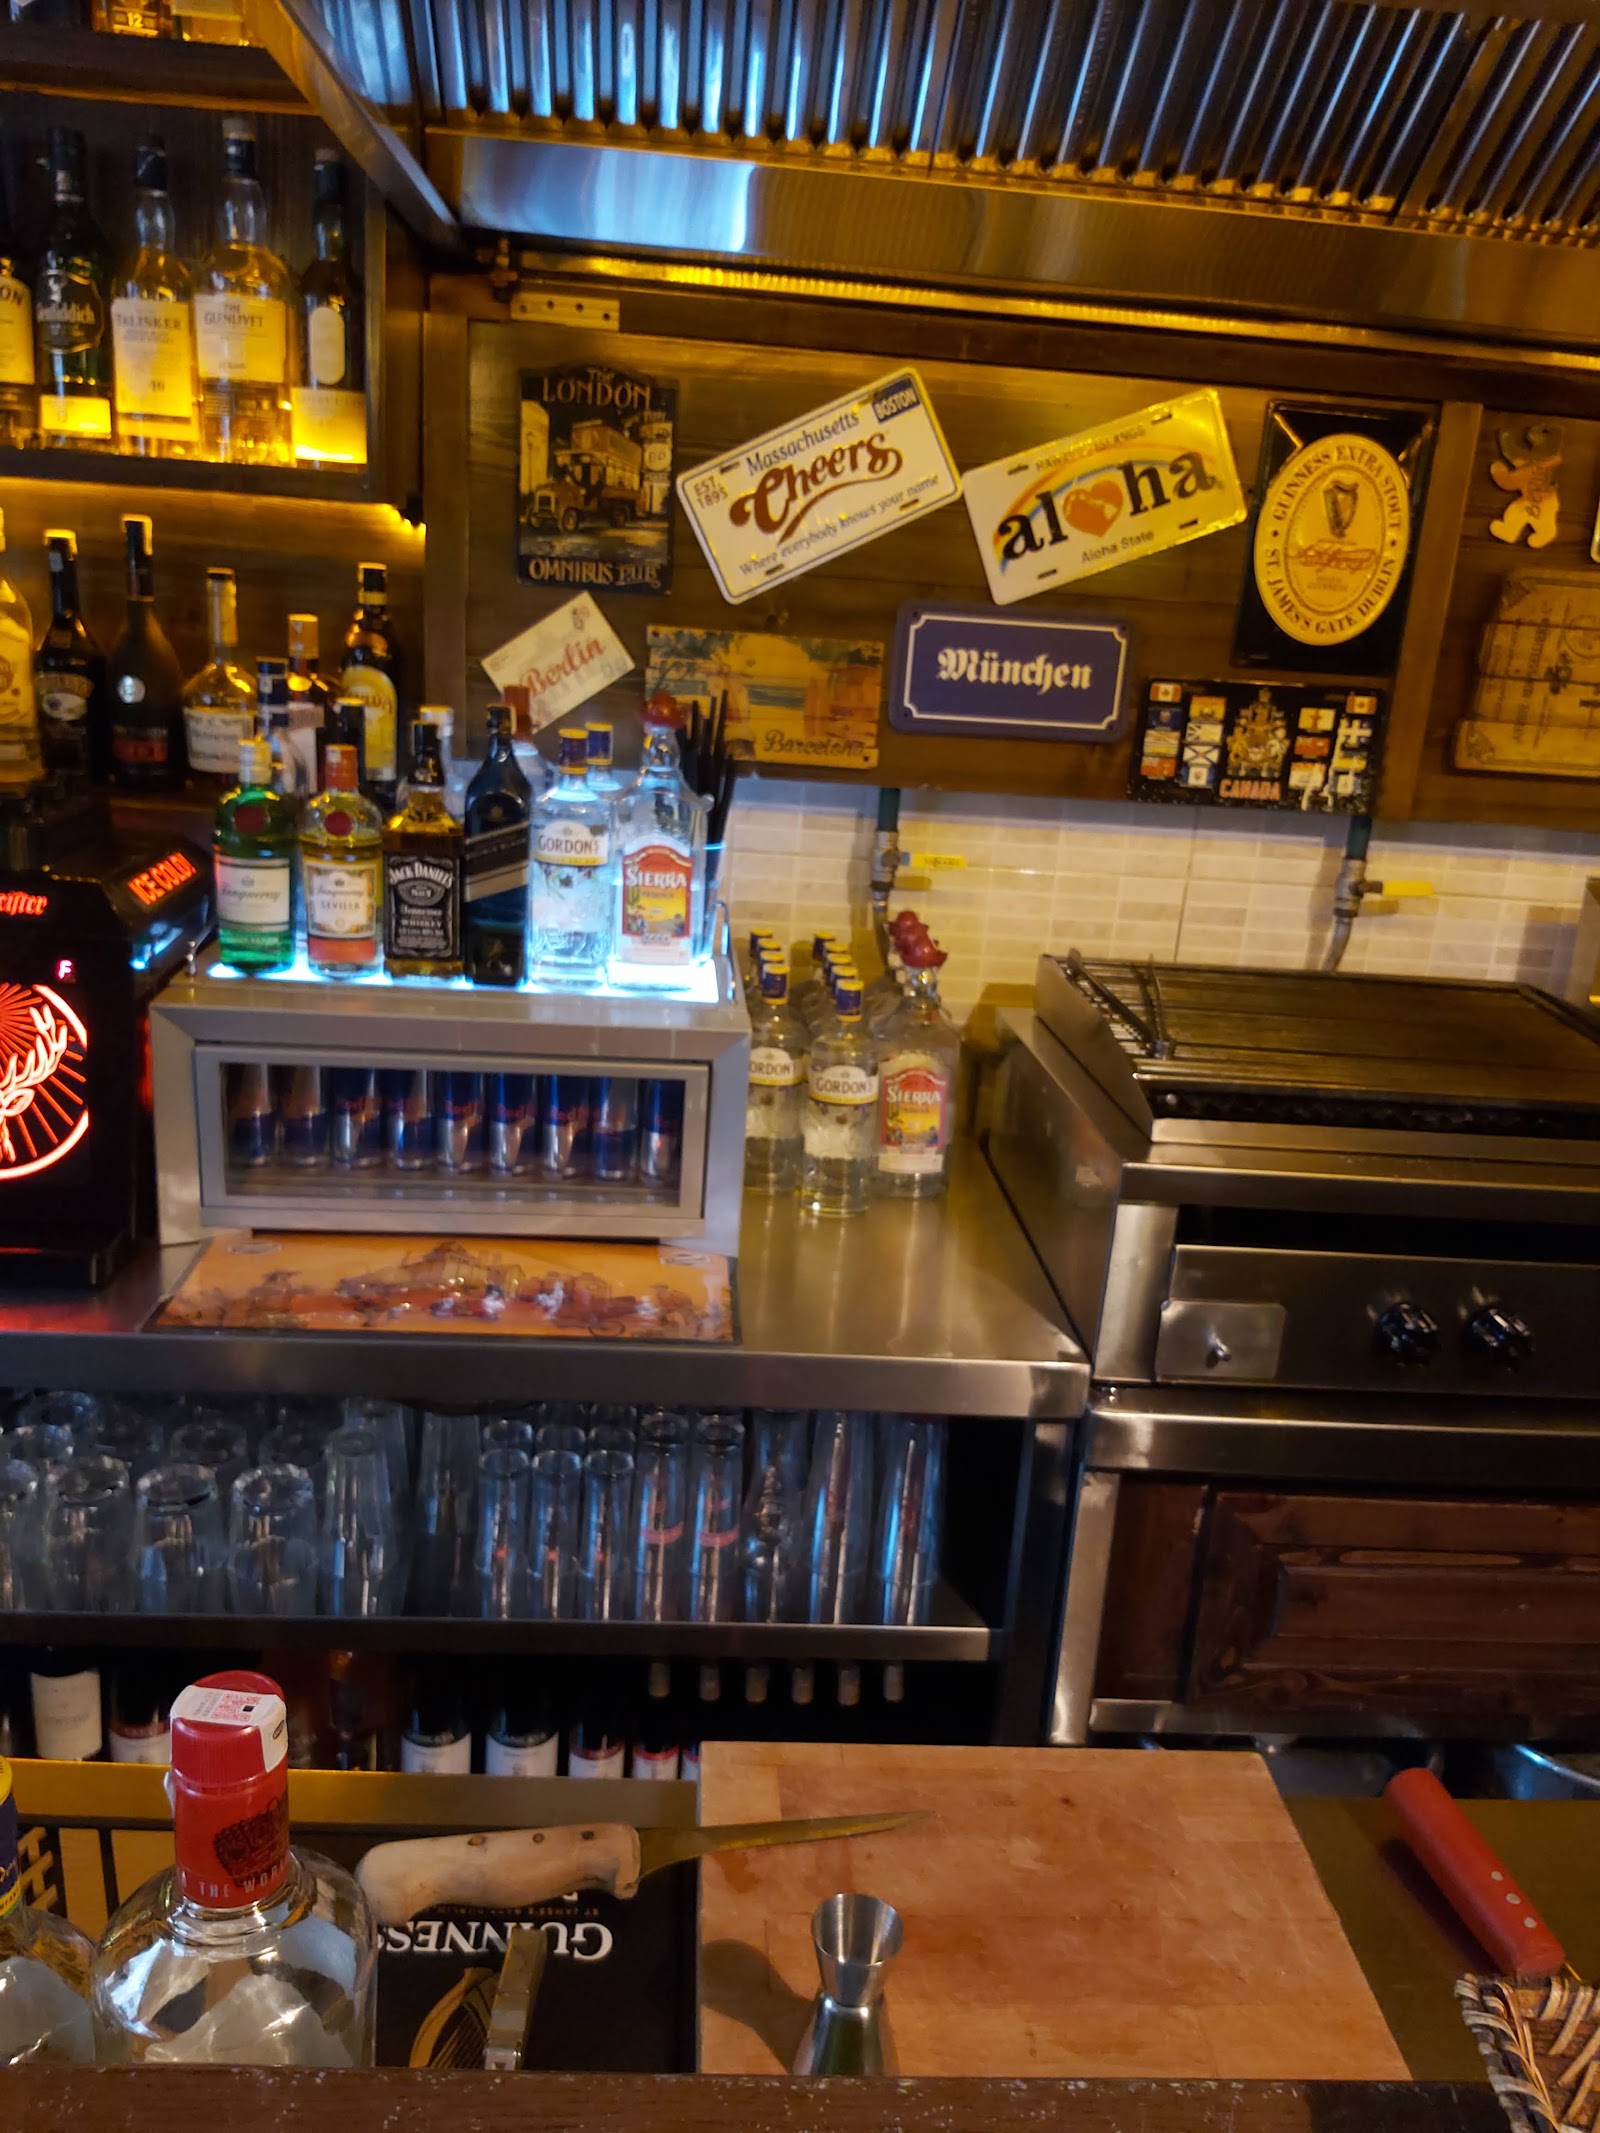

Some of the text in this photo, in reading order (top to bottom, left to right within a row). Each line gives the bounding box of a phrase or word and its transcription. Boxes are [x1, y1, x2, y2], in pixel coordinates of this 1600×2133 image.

[126, 12, 144, 28] 12
[542, 376, 652, 409] LONDON
[873, 387, 918, 422] BOSTON
[745, 411, 861, 477] Massachusetts
[729, 431, 904, 546] Cheers
[1273, 445, 1401, 529] GUINNESS EXTRA STOUT
[739, 474, 940, 576] Where everybody knows your name
[1080, 530, 1155, 564] Aloha State
[528, 557, 661, 588] OMNIBUS PUB
[1314, 614, 1358, 635] GATE
[1356, 557, 1396, 618] DUBLIN
[520, 637, 605, 696] Berlin
[936, 648, 1093, 696] München
[1219, 778, 1281, 801] CANADA
[128, 872, 166, 905] ICE
[388, 865, 414, 886] JACK
[626, 865, 687, 889] SIERRA
[58, 960, 72, 979] F
[886, 1084, 942, 1105] SIERRA
[199, 1881, 230, 1899] THE
[243, 1858, 287, 1894] WOR
[376, 1921, 614, 1961] GUNNES
